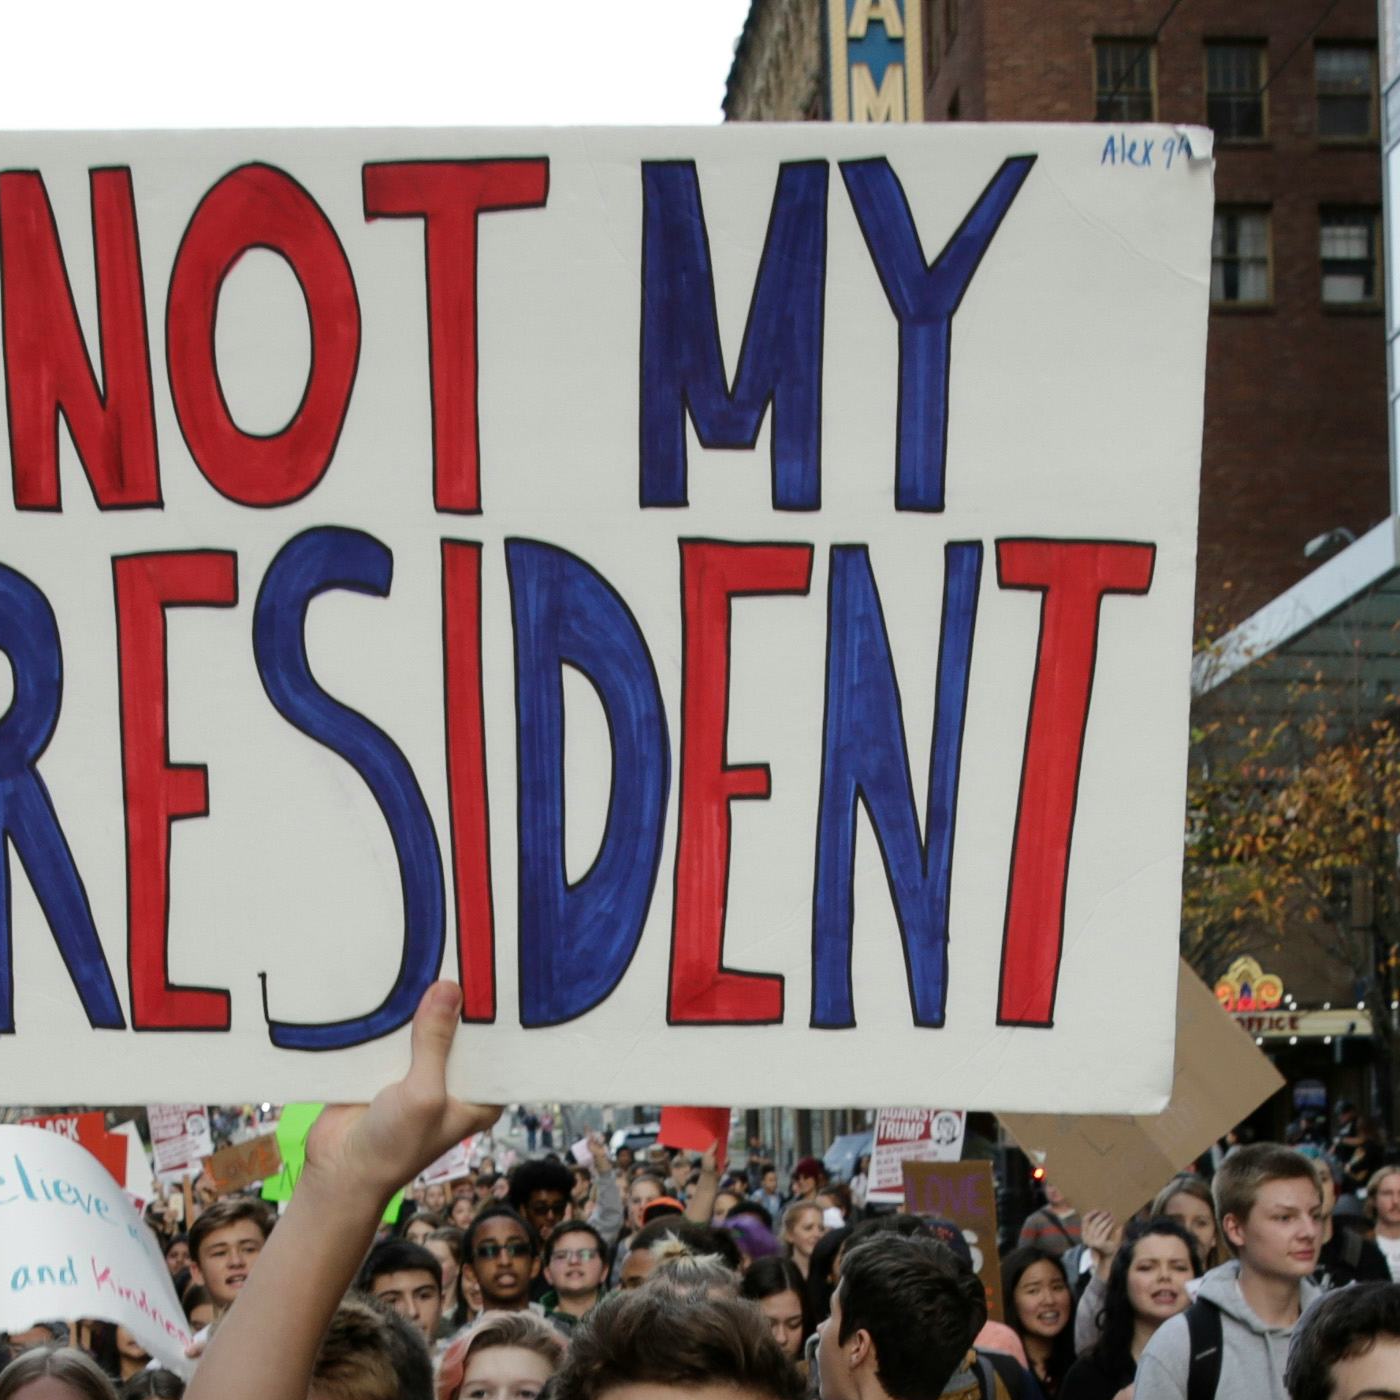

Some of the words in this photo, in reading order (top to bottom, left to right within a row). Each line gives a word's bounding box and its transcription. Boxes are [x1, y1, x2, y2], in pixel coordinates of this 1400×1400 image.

[1101, 133, 1154, 167] Alex
[639, 153, 1038, 514] MY
[1236, 1015, 1299, 1031] FFICE
[878, 1121, 924, 1140] TRUMP
[906, 1173, 987, 1216] LOVE
[11, 1255, 78, 1292] and
